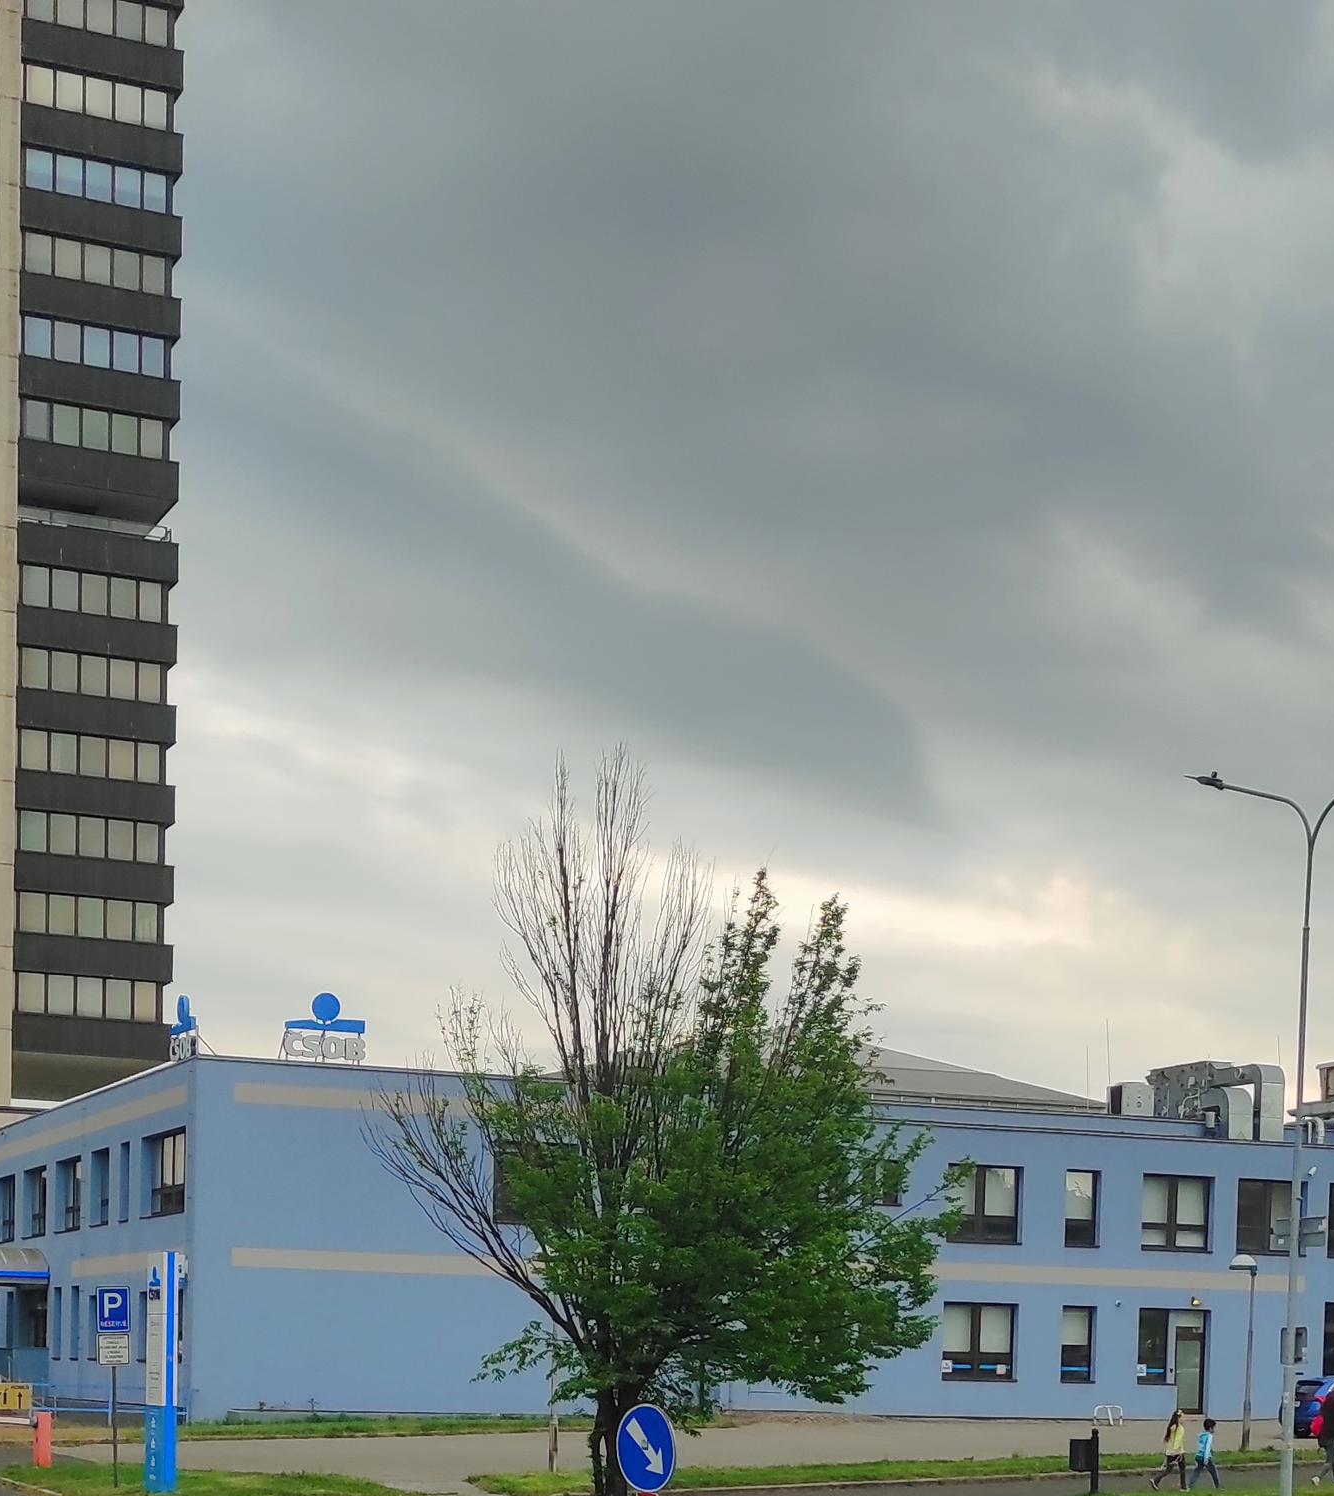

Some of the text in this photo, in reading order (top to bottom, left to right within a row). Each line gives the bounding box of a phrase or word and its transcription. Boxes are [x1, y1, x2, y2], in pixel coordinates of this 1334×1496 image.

[169, 1035, 192, 1062] ČSOB
[284, 1030, 366, 1061] ČSOB
[103, 1292, 123, 1318] P
